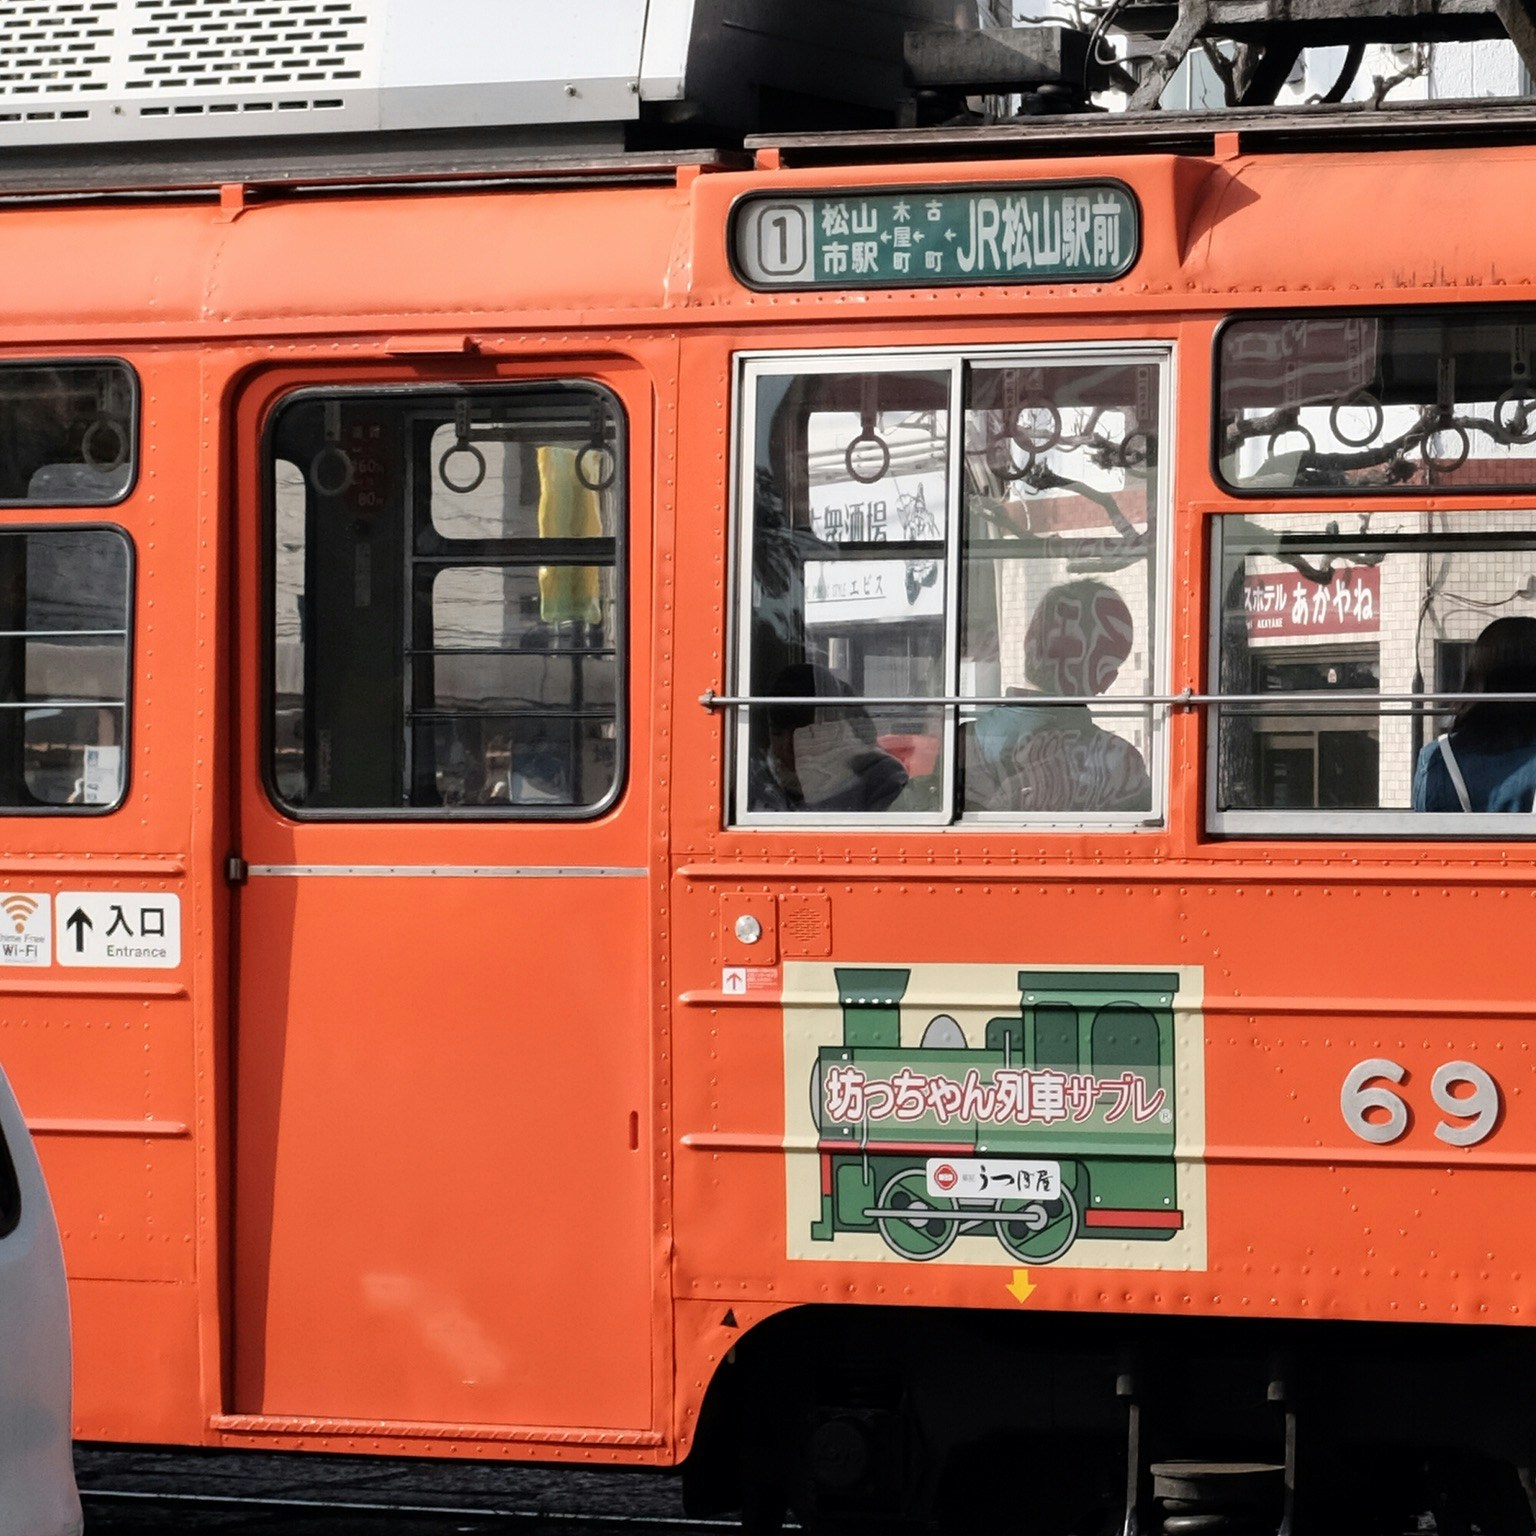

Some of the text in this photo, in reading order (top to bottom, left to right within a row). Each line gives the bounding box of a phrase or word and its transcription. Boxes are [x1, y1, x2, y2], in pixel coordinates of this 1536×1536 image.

[821, 202, 878, 236] 松山
[892, 201, 912, 274] 木屋町
[925, 199, 942, 274] 古町
[956, 194, 1122, 272] JR松山駅前
[821, 241, 879, 275] 市駅
[850, 574, 884, 596] エビス
[1291, 578, 1374, 625] あかやね
[105, 904, 165, 938] 入口
[2, 944, 38, 958] Wi-Fi
[106, 944, 168, 958] Entrance
[824, 1067, 1167, 1125] 坊っちゃん列車サブレ
[1340, 1057, 1499, 1147] 69
